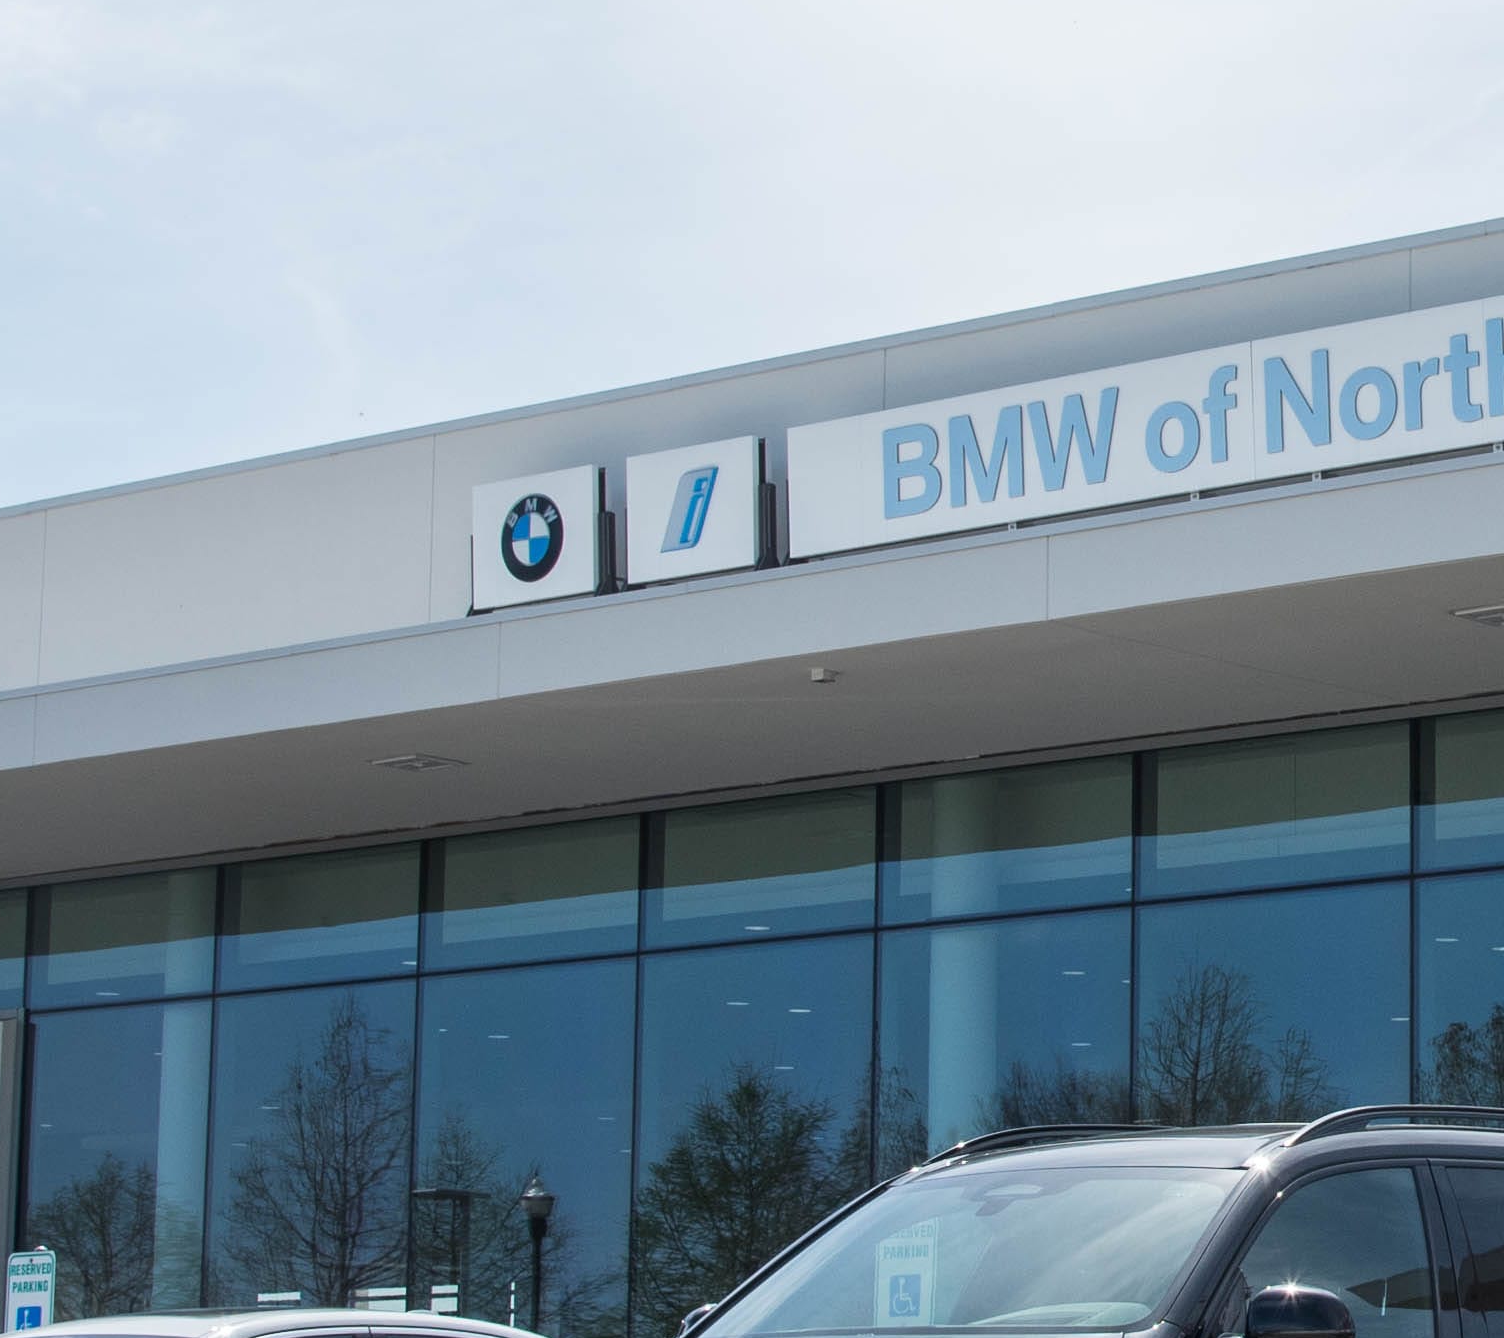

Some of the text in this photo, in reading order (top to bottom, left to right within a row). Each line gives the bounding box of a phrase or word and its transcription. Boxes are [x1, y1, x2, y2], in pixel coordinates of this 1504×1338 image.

[882, 387, 1120, 520] BMW
[1145, 365, 1238, 474] of
[506, 498, 558, 528] BMW
[10, 1263, 52, 1276] RESERVED
[12, 1280, 49, 1293] PARKING
